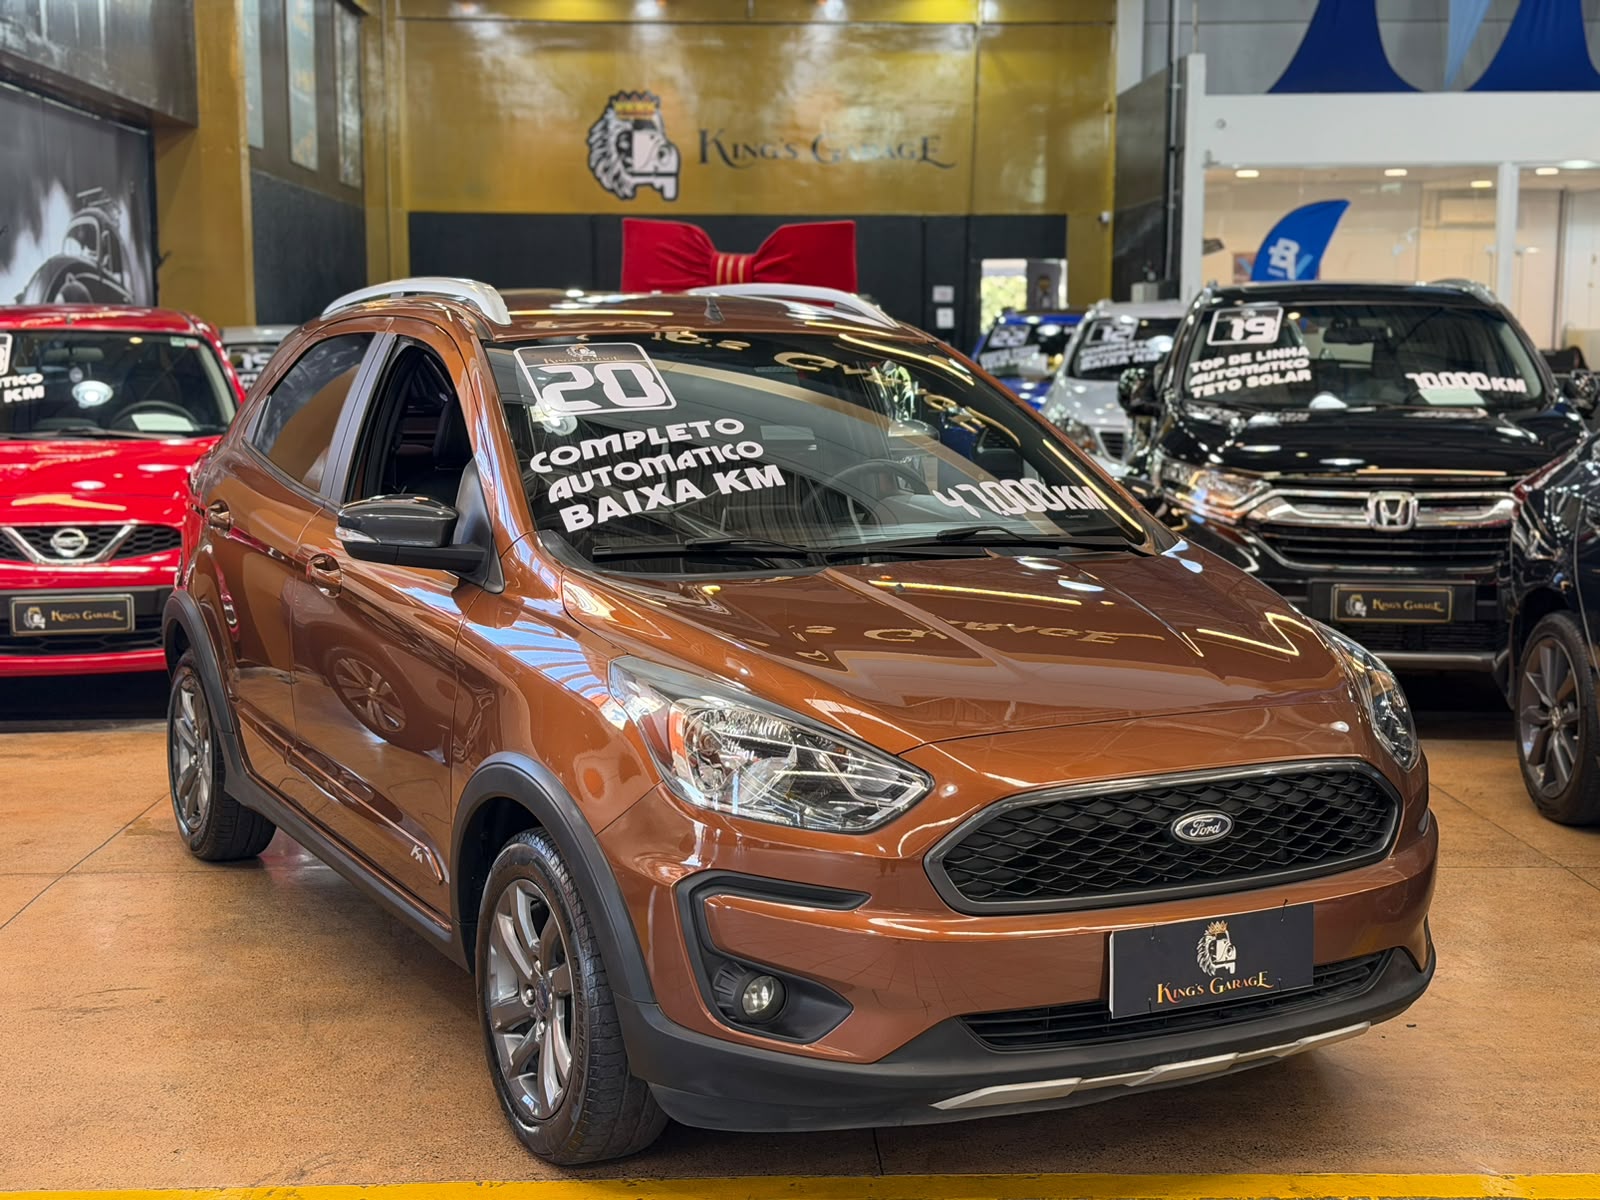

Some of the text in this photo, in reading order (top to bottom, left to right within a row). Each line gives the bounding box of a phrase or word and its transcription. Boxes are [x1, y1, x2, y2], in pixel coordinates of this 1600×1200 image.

[1230, 316, 1277, 342] 19
[1190, 346, 1310, 373] TOP DE LINHA
[3, 385, 45, 403] KM
[538, 363, 667, 412] 20
[1190, 369, 1312, 399] TETO SOLAR
[530, 418, 745, 473] COMPLETO
[548, 441, 764, 503] AUTOMATICO
[559, 464, 786, 533] BAIXA KM
[1189, 818, 1222, 837] Ford
[1157, 971, 1274, 1004] KING'S GARAGE
